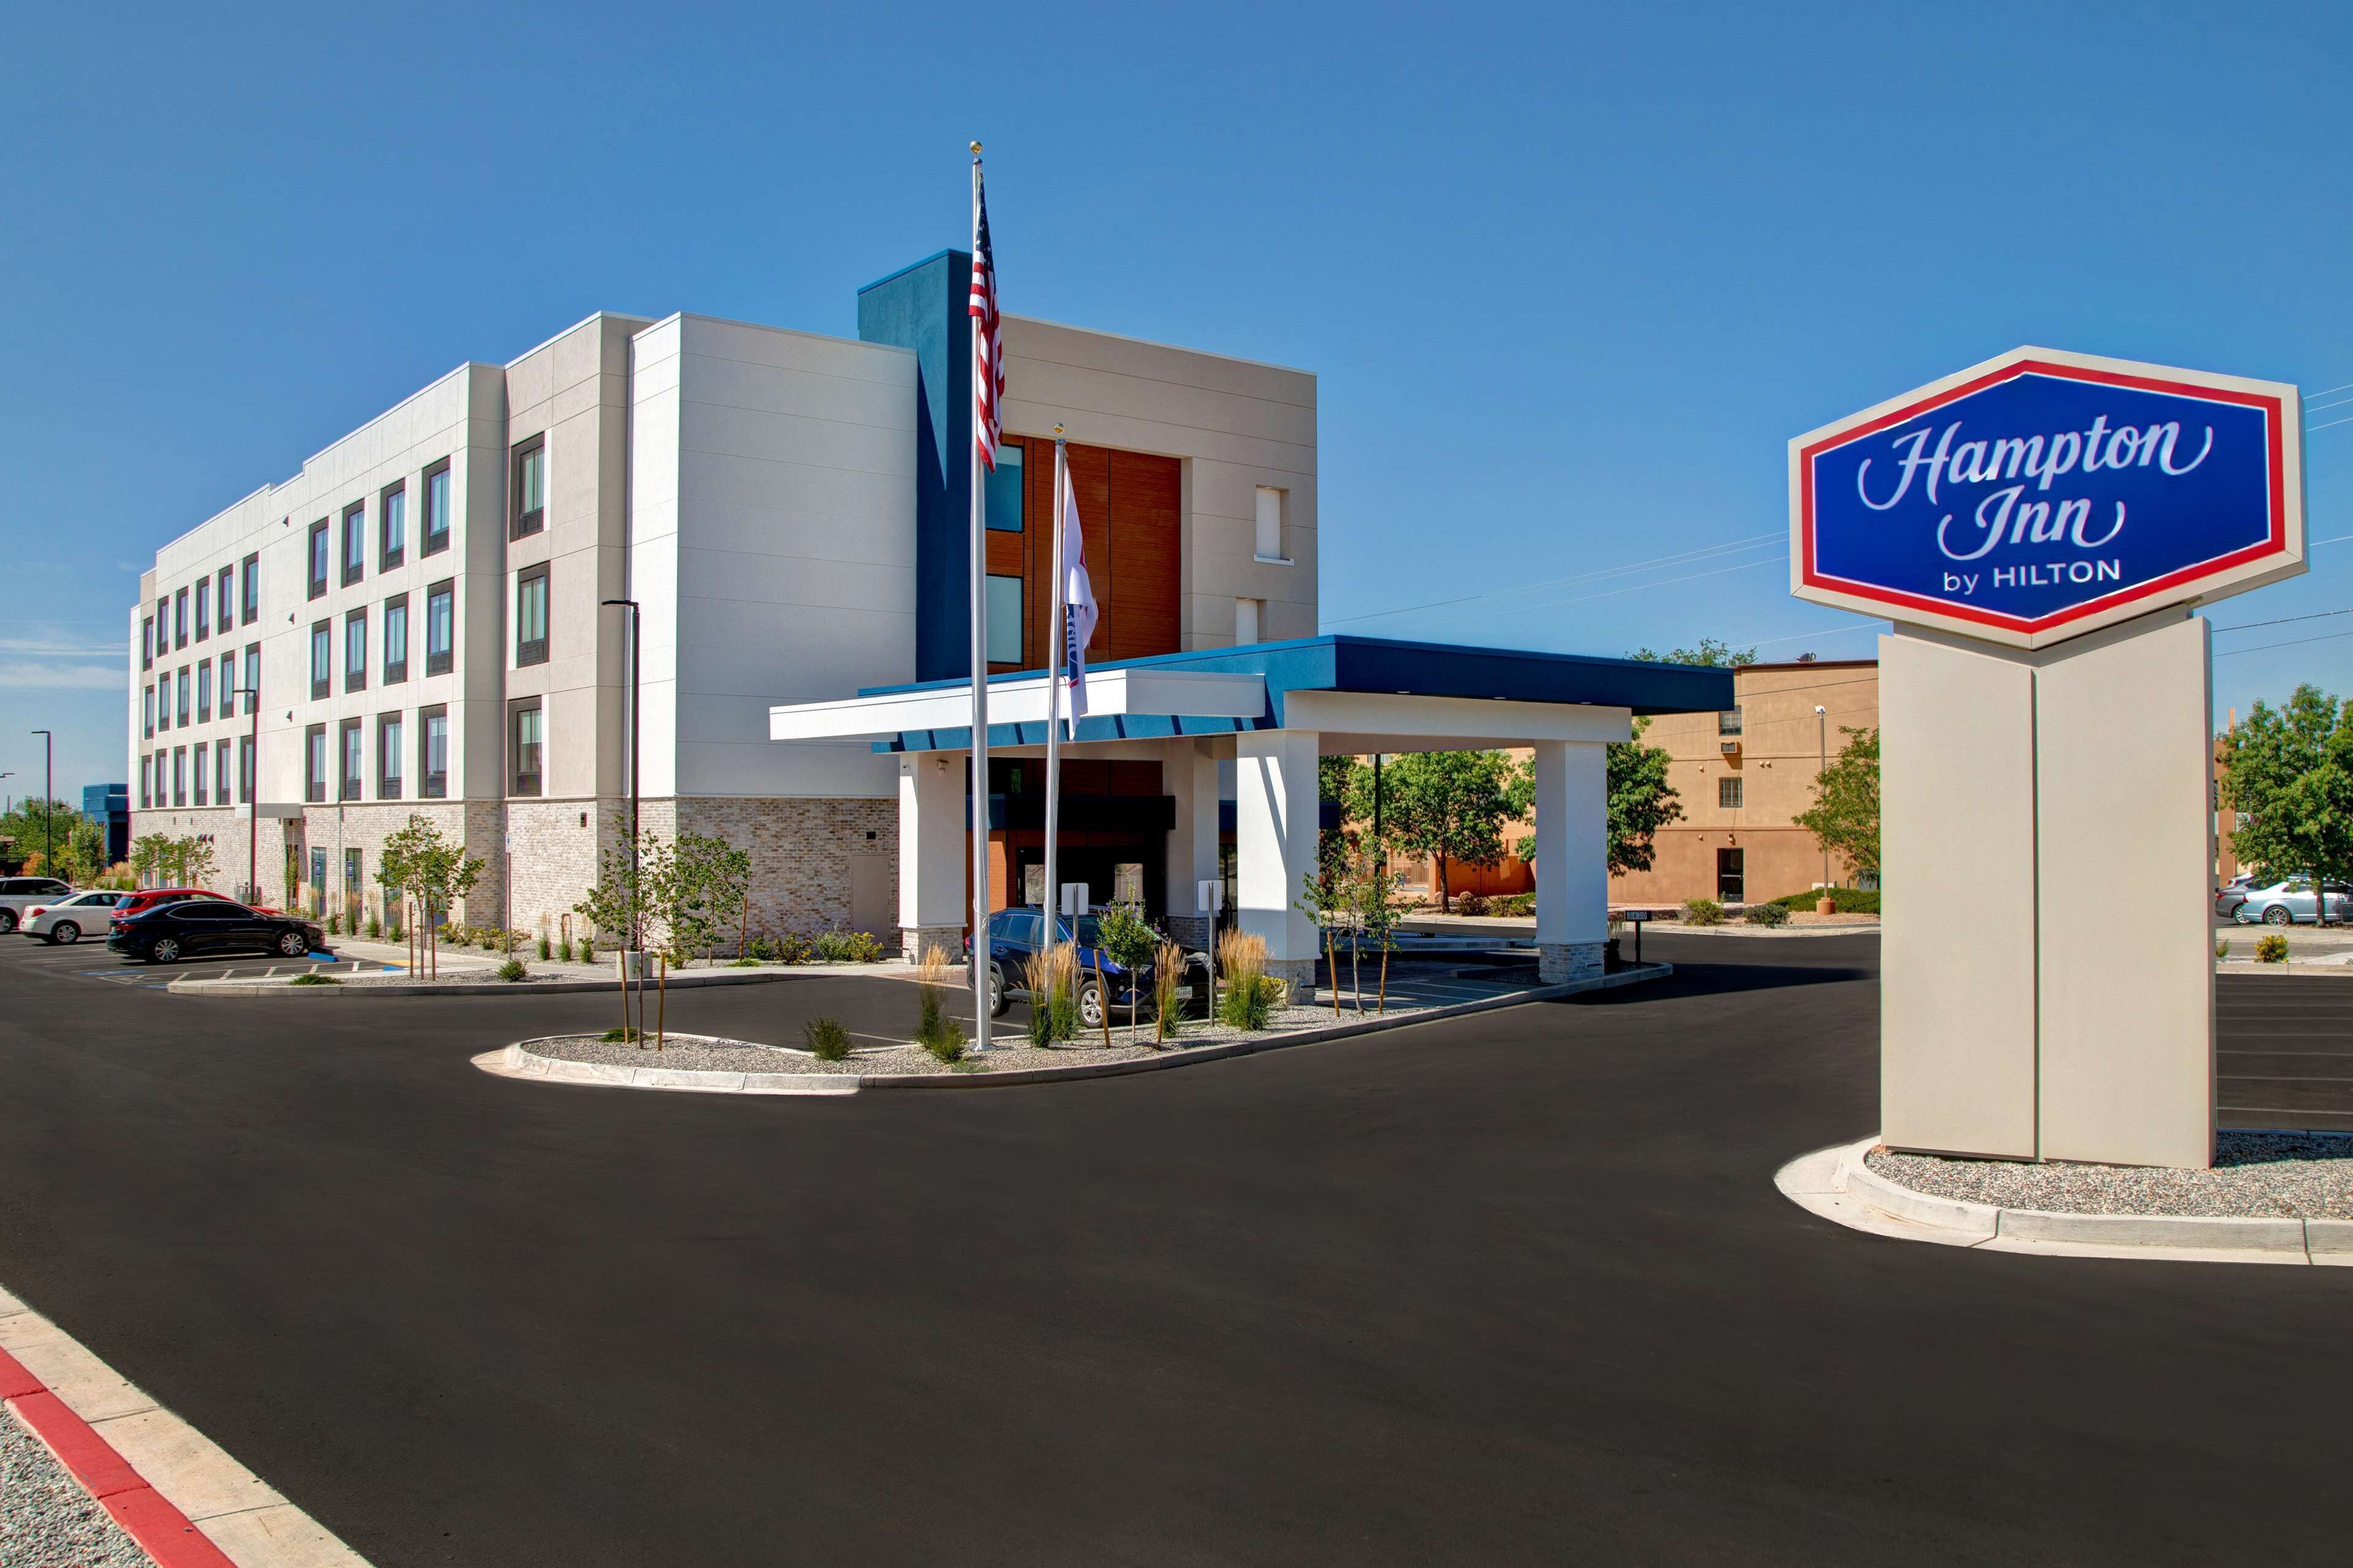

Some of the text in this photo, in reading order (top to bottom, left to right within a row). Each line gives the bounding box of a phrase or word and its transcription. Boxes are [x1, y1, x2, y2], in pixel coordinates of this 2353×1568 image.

[1858, 414, 2213, 510] Hampton
[1937, 484, 2126, 561] Inn
[1944, 558, 2120, 596] by HILTON
